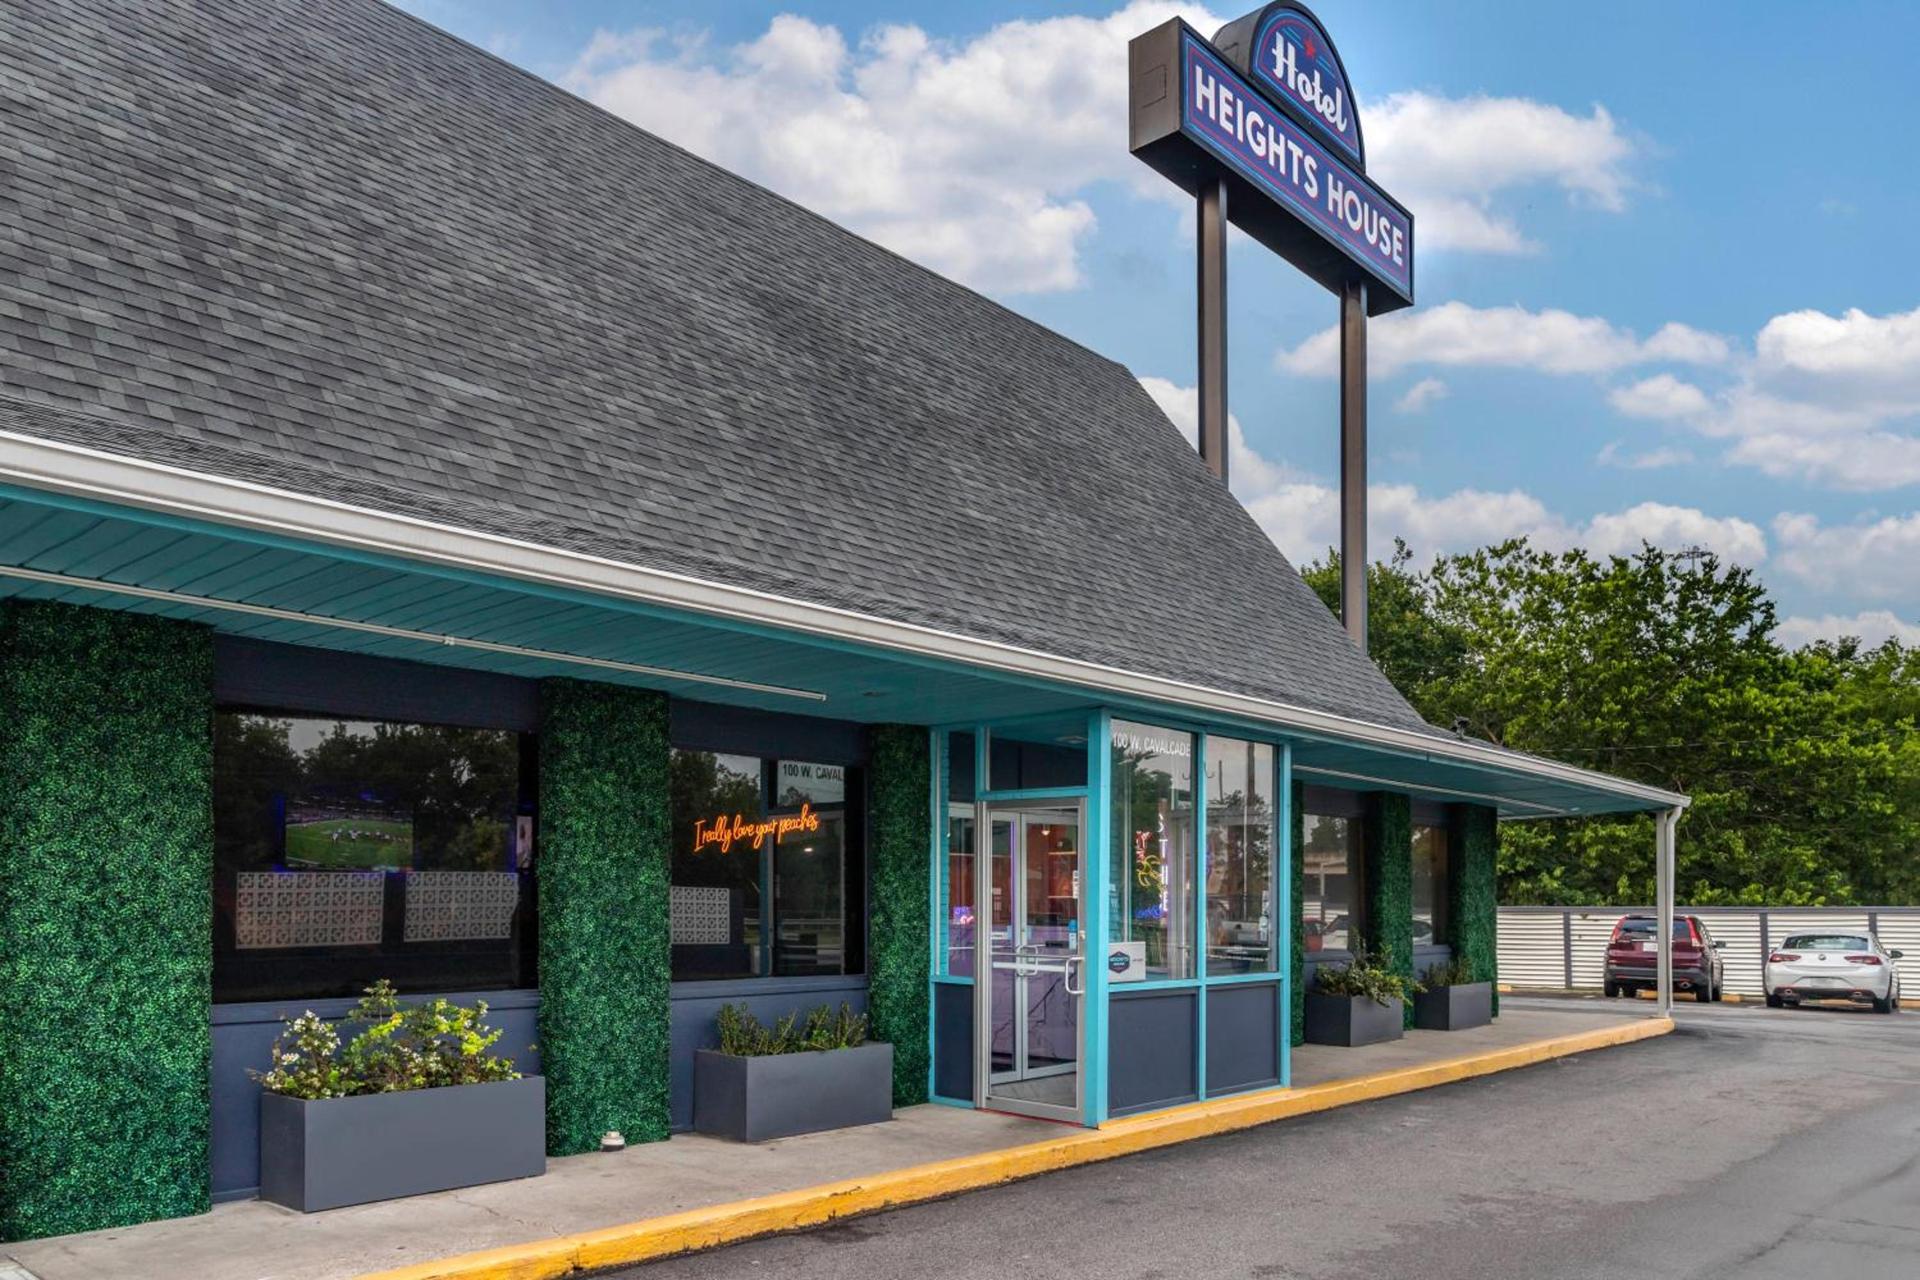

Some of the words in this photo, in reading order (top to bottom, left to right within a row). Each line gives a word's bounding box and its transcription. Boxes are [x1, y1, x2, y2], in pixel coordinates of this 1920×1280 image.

[1272, 31, 1348, 133] Hotel
[1195, 64, 1319, 199] HEIGHTS
[1327, 172, 1404, 267] HOUSE
[1113, 731, 1128, 749] 100
[783, 763, 799, 777] 100
[694, 820, 706, 852] I
[702, 815, 732, 853] really
[733, 814, 755, 840] love
[753, 820, 778, 849] your
[777, 803, 818, 844] peaches
